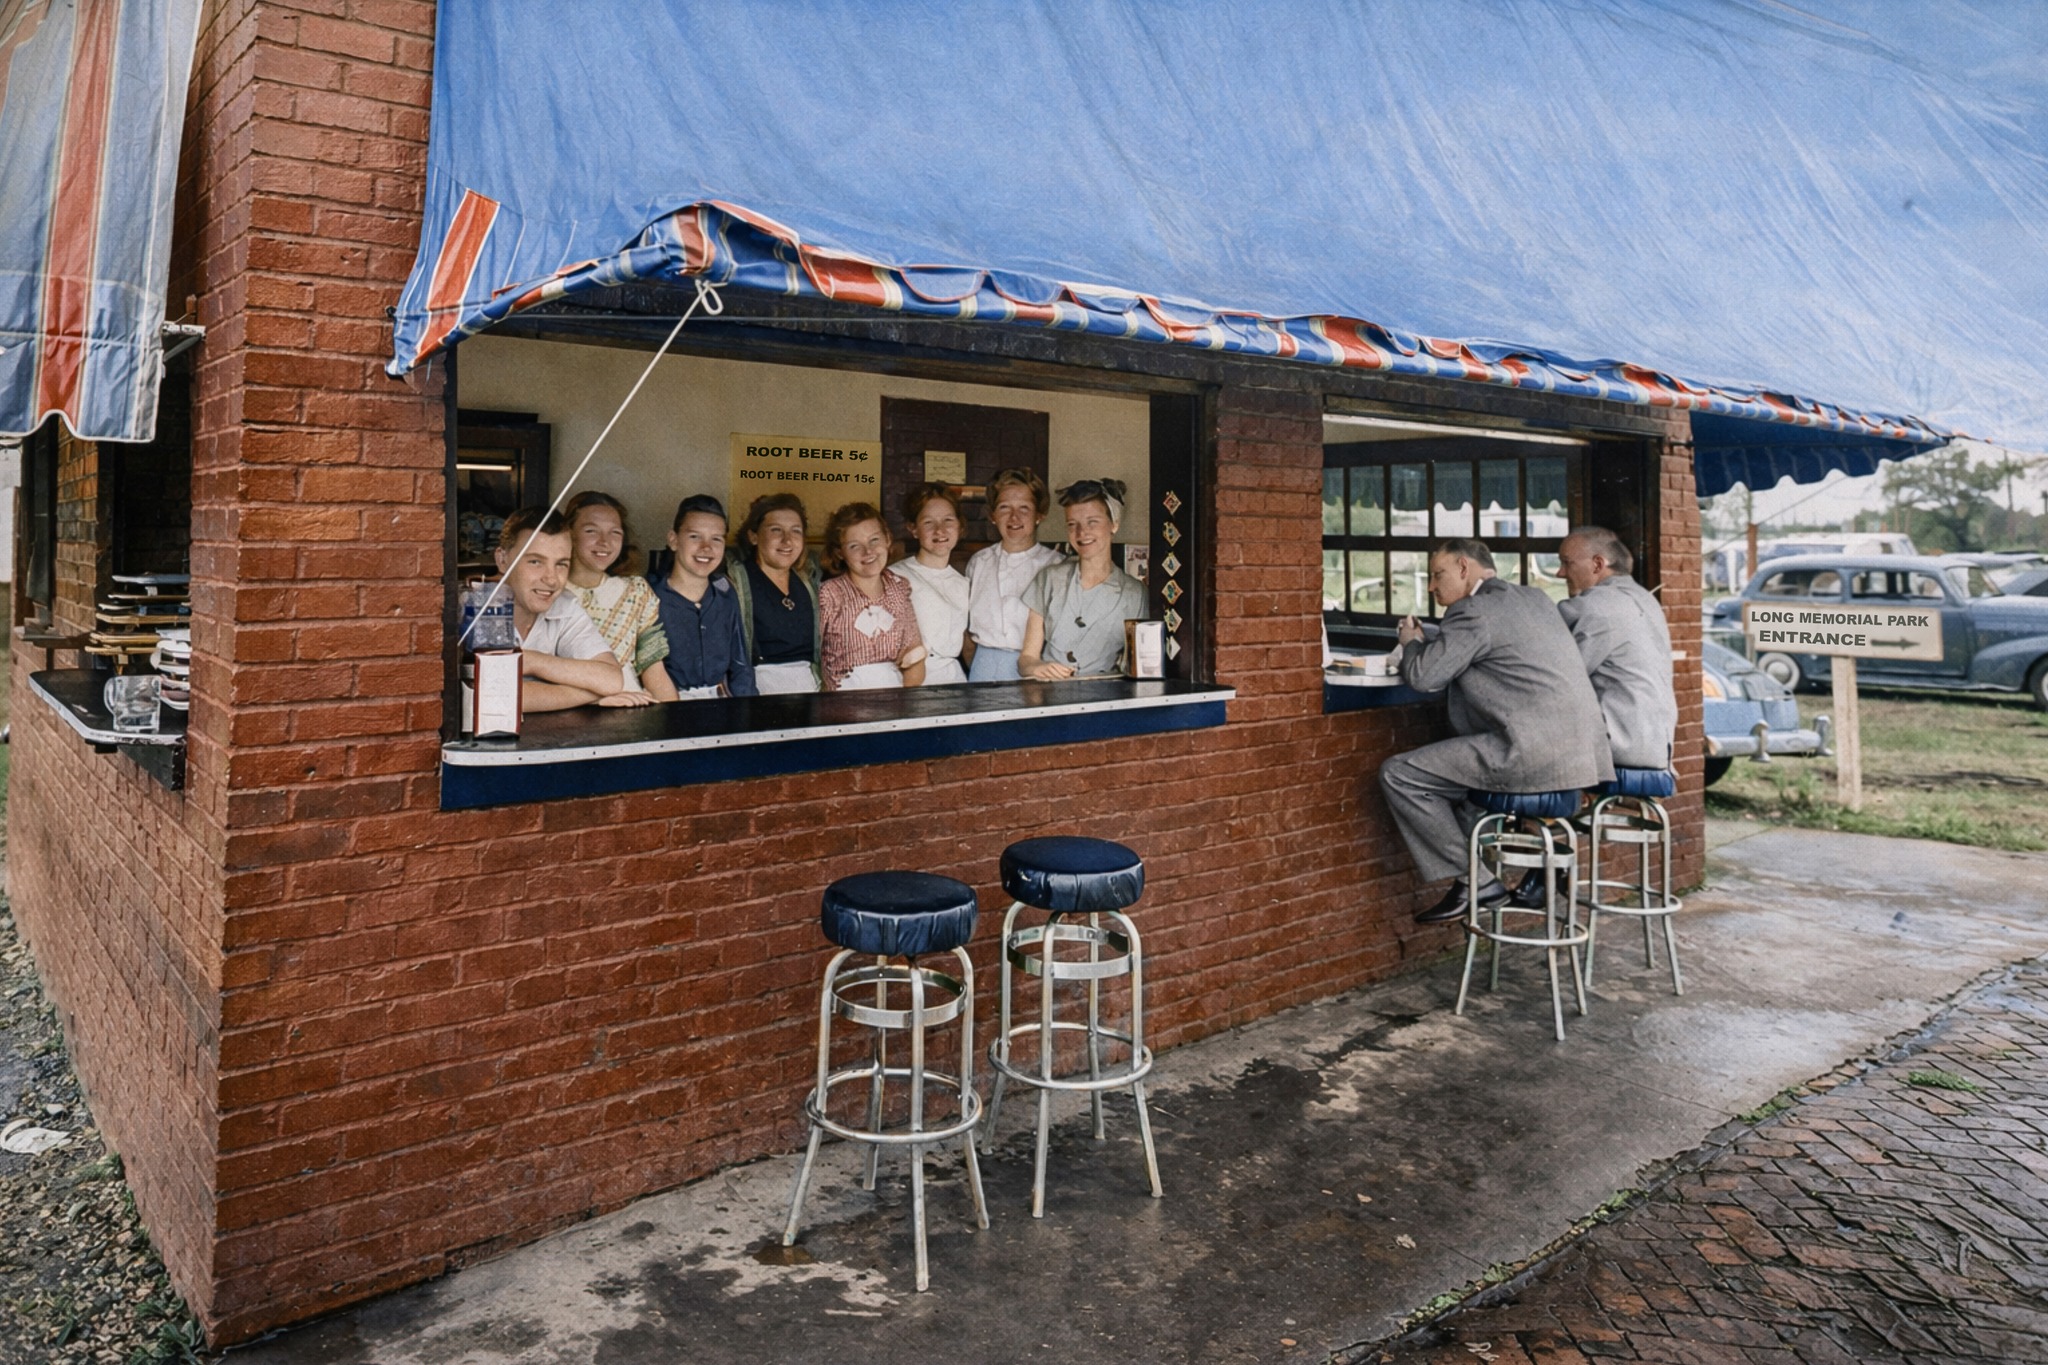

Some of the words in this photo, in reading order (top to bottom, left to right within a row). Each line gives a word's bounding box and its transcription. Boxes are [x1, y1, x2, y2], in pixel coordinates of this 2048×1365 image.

[746, 446, 793, 458] ROOT
[799, 448, 843, 460] BEER
[849, 451, 868, 462] 5¢
[740, 470, 773, 480] ROOT
[777, 471, 809, 481] BEER
[812, 472, 850, 483] FLOAT
[854, 474, 875, 484] 15¢
[1751, 611, 1794, 624] LONG
[1799, 612, 1882, 626] MEMORIAL
[1887, 615, 1929, 627] PARK
[1759, 630, 1866, 646] ENTRANCE
